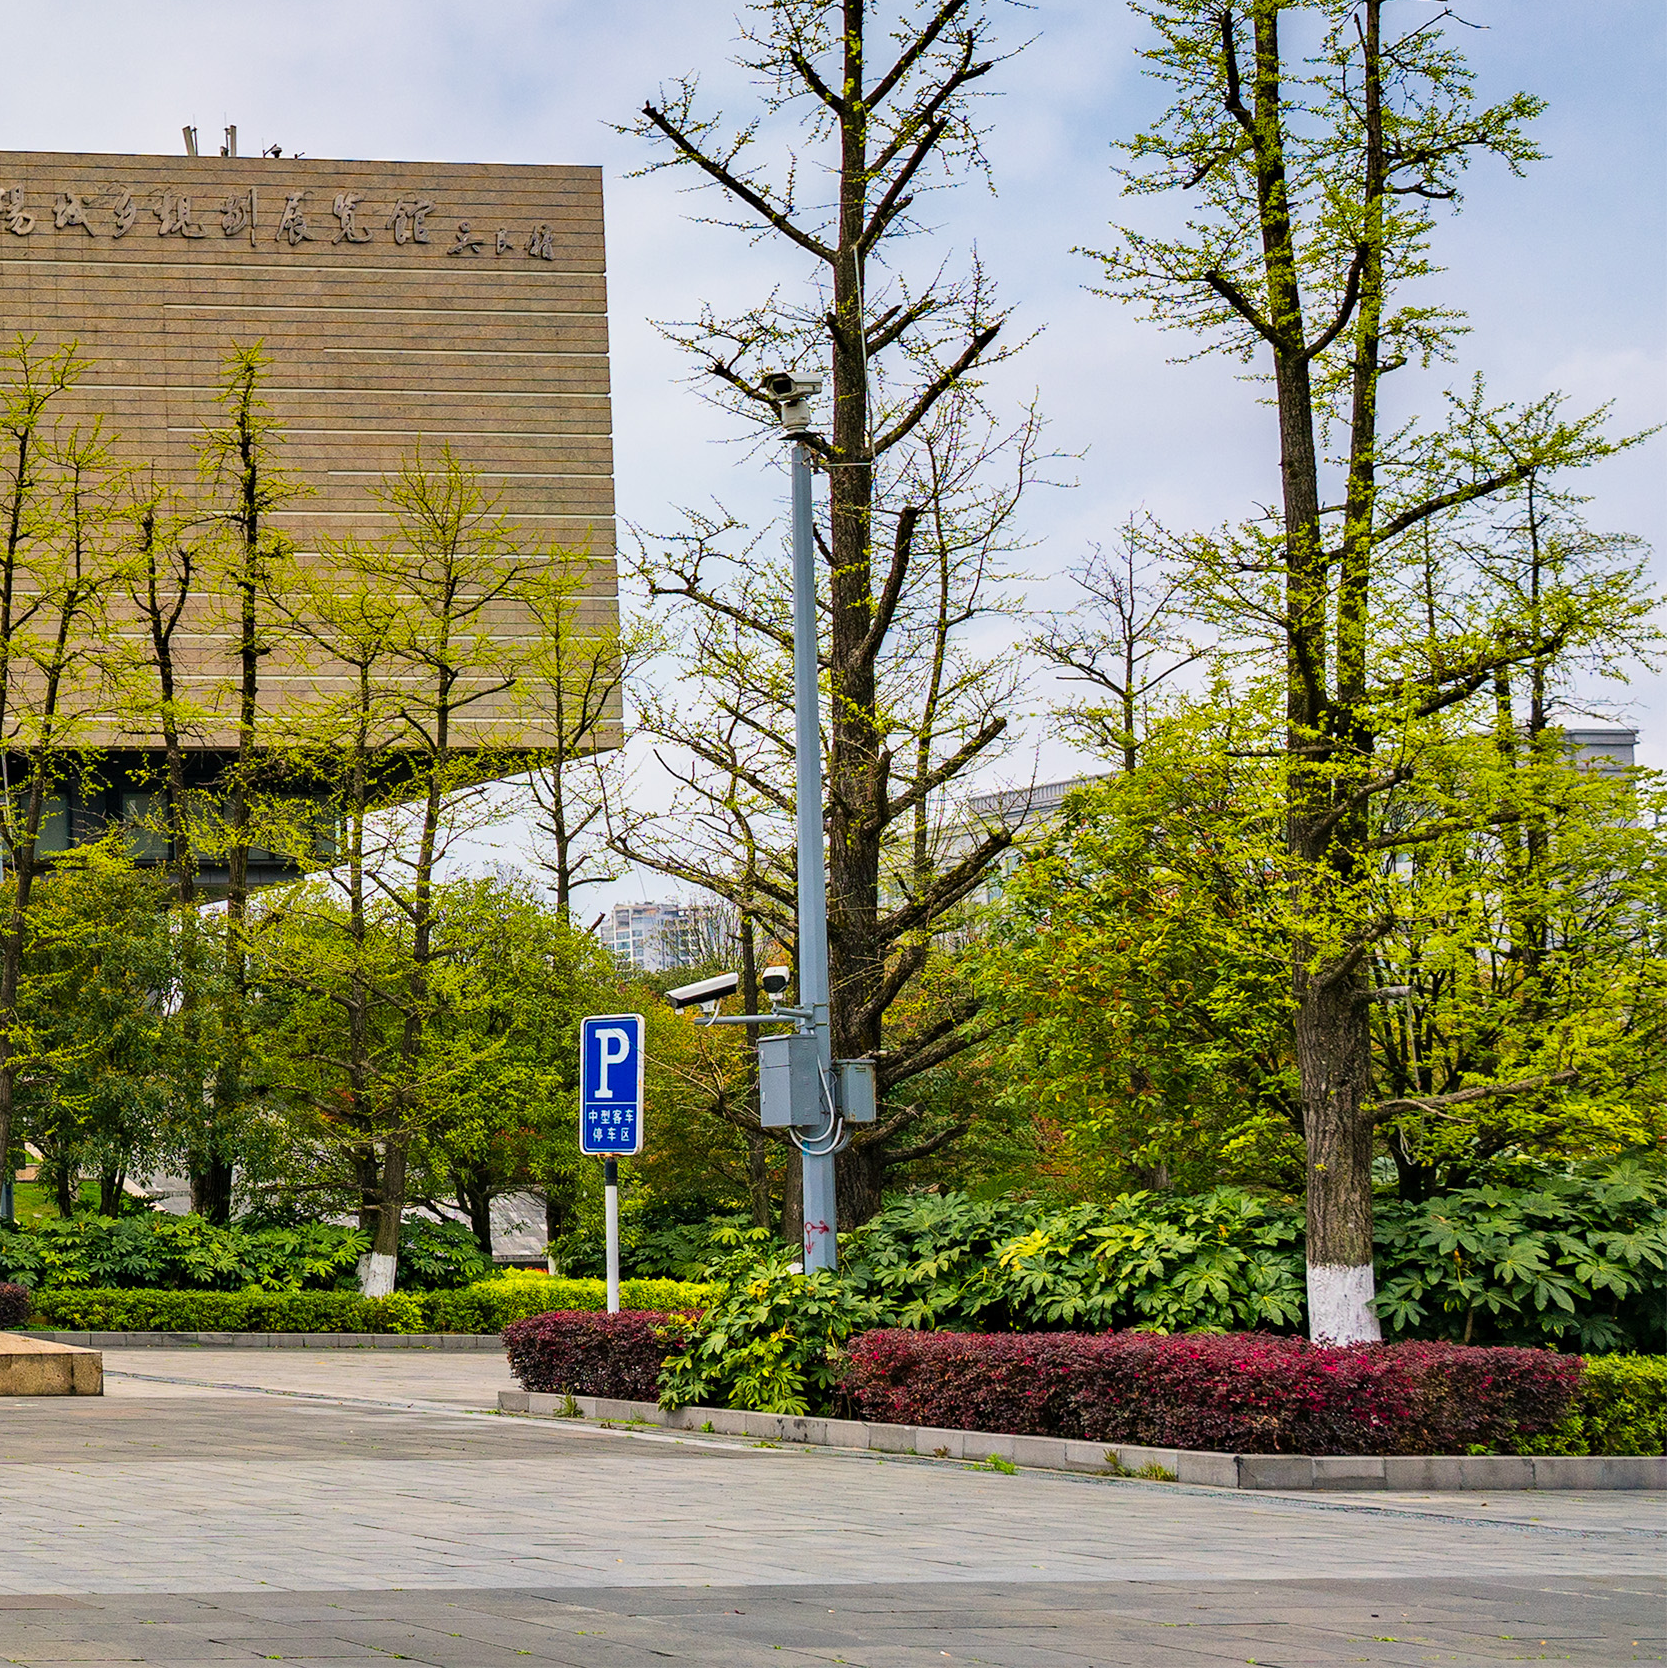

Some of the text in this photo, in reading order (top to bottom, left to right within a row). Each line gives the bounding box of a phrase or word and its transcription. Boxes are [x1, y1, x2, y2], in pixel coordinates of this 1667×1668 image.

[594, 1027, 630, 1099] P
[588, 1109, 634, 1125] 中型客车
[593, 1127, 630, 1142] 停车区
